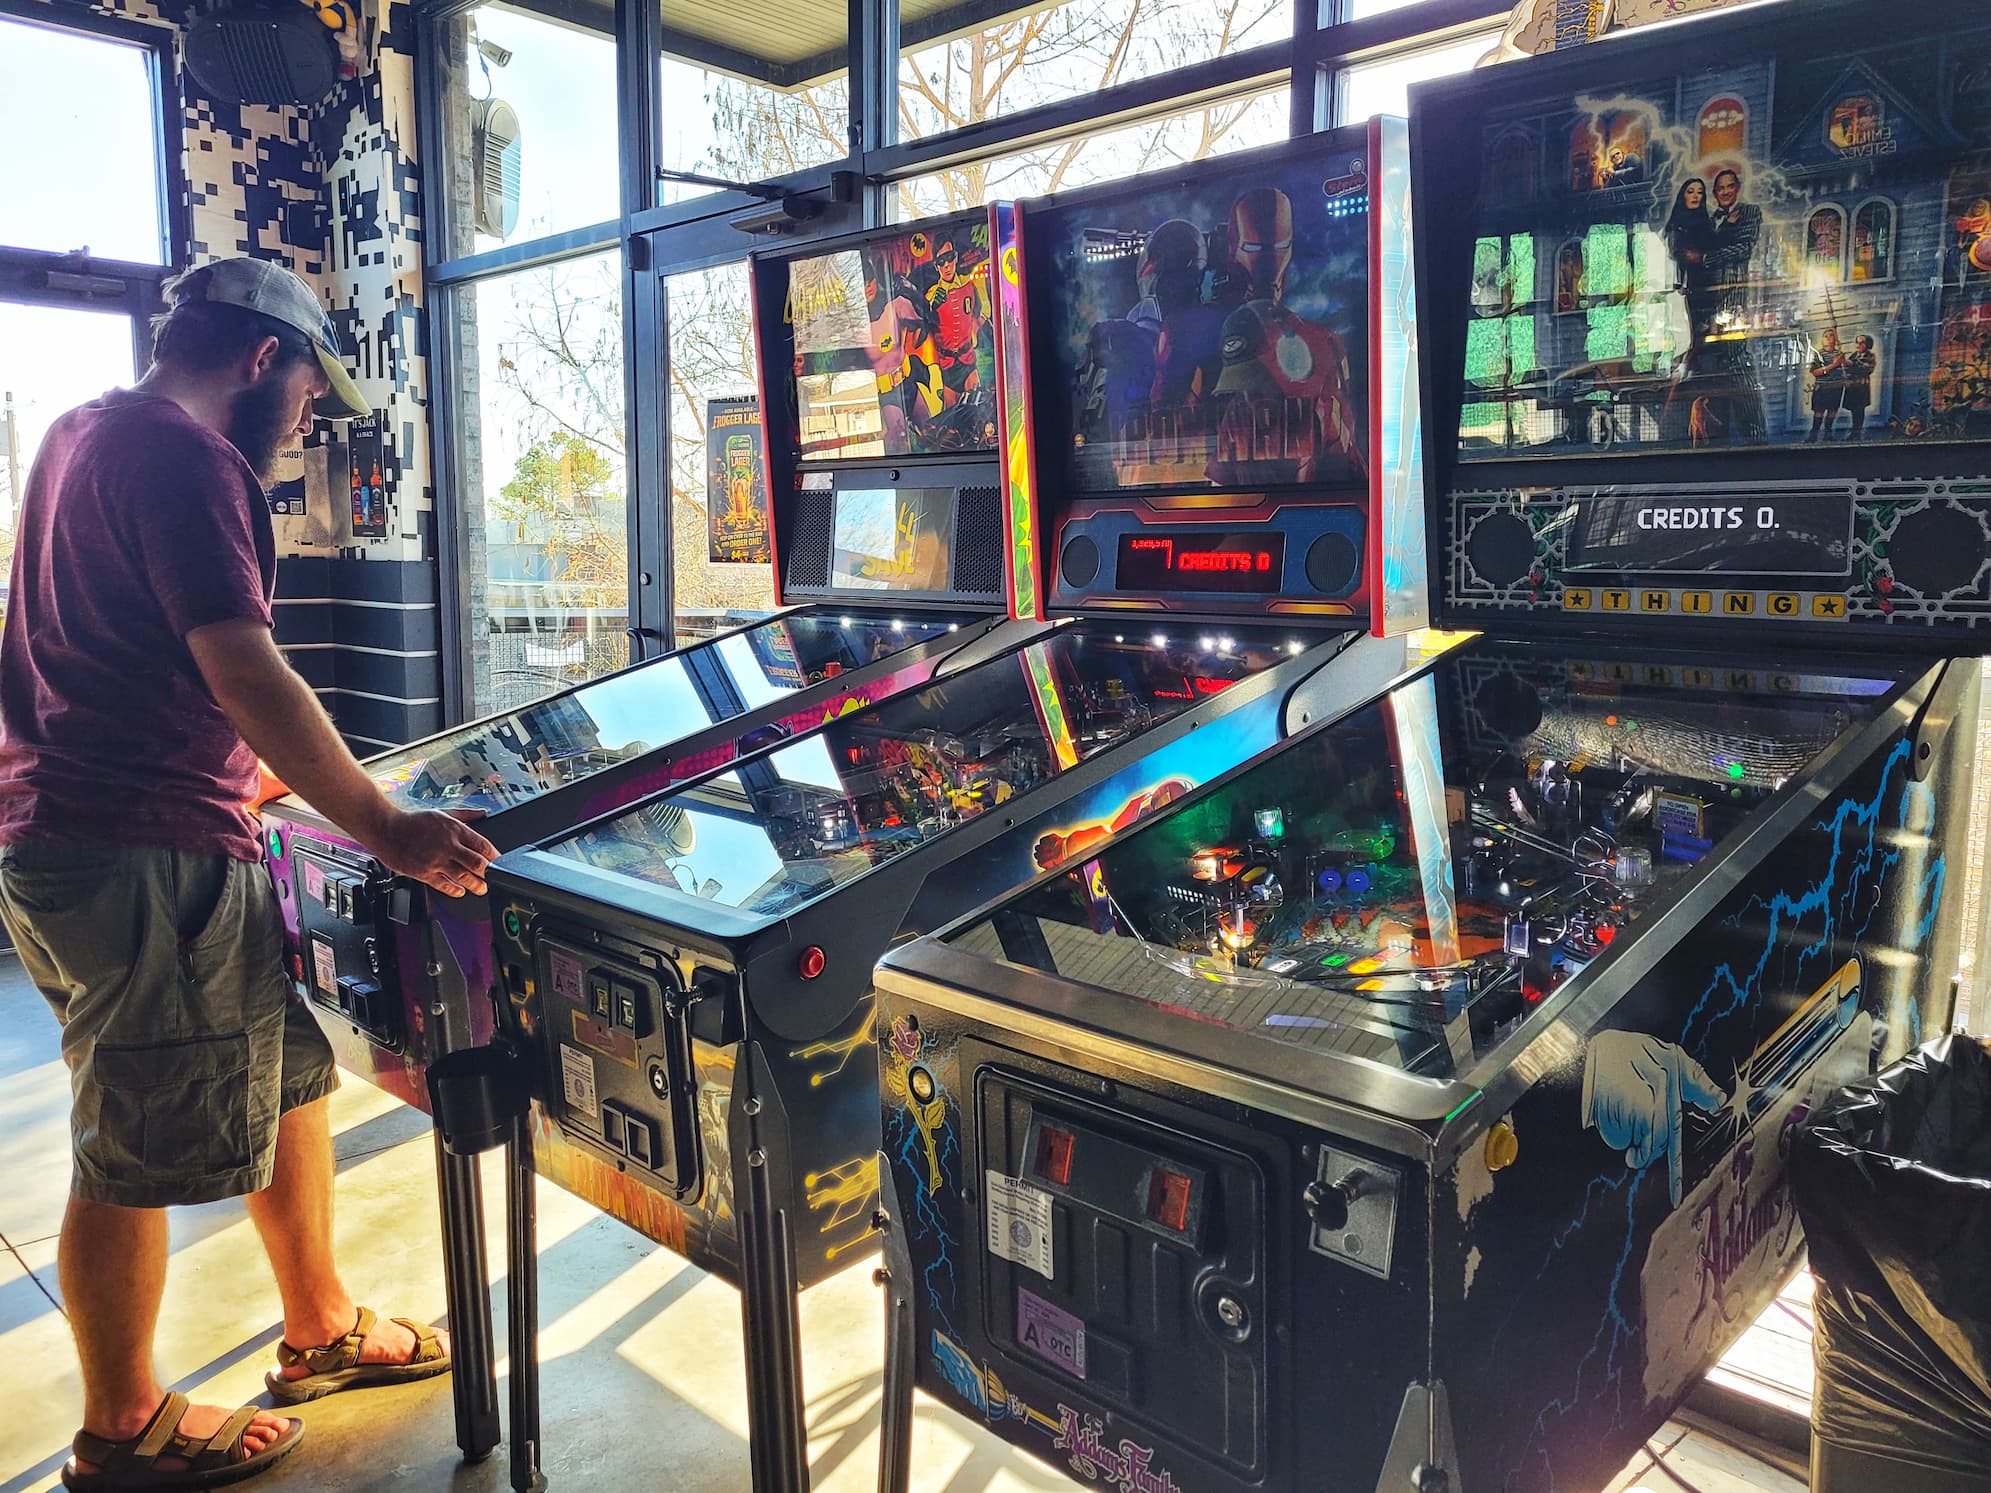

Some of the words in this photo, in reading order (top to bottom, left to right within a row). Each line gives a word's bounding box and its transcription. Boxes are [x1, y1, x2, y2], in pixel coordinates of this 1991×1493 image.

[970, 224, 989, 251] ZA
[712, 413, 743, 429] FROGGER
[744, 412, 762, 425] LAGE
[731, 456, 751, 467] LAGER
[1637, 506, 1744, 529] CREDITS
[1178, 552, 1252, 571] CREDITS
[1004, 1177, 1035, 1195] PERMIT
[1024, 1322, 1040, 1350] A
[1050, 1336, 1072, 1358] OTC
